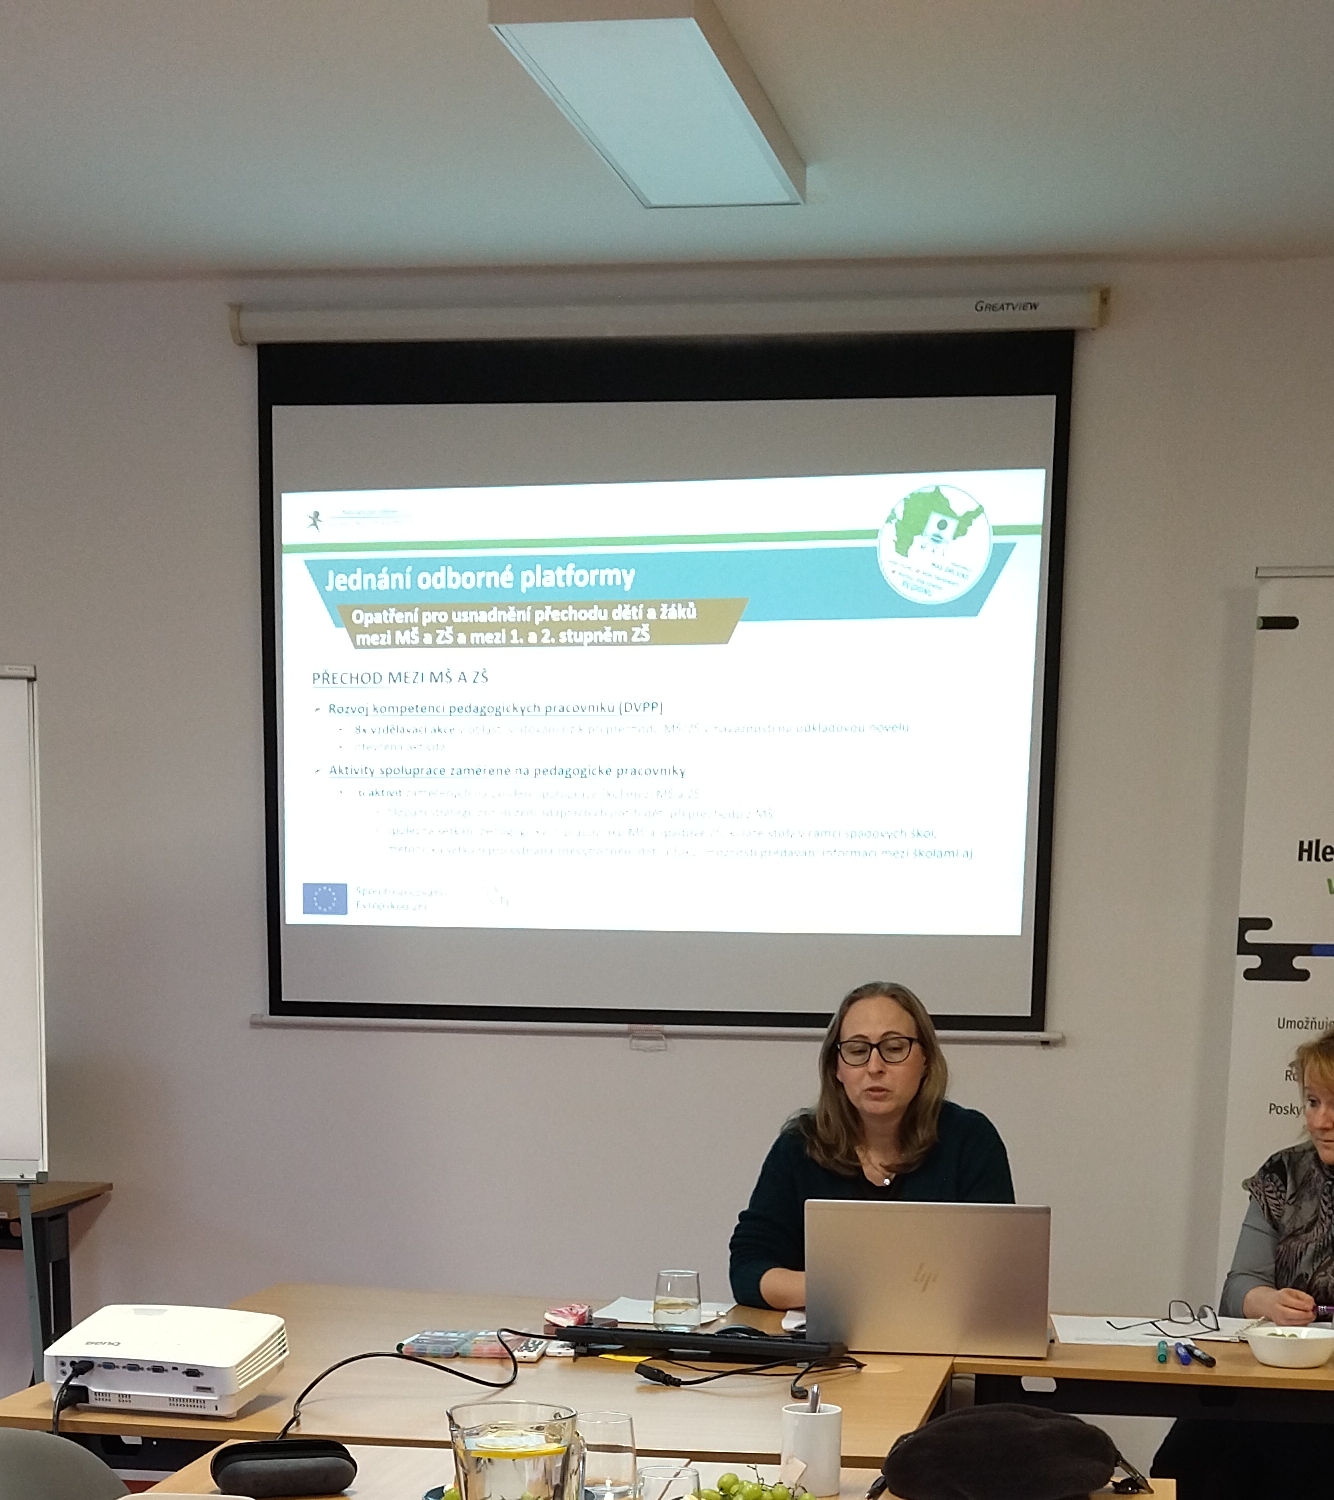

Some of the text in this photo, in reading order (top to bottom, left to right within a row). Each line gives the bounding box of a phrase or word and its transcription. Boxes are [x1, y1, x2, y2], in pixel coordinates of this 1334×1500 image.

[325, 564, 636, 593] Jednání odborné platformy
[352, 602, 697, 626] Opatření pro usnadnění přechodu dětí a žáků
[356, 624, 651, 646] mezi MŠ a ZŠ a mezi 1. a 2. stupněm ZŠ
[312, 668, 489, 685] PŘECHOD MEZI MŠ A ZŠ
[328, 703, 369, 716] Rozvoj
[329, 765, 375, 778] Aktivity
[515, 767, 530, 776] na
